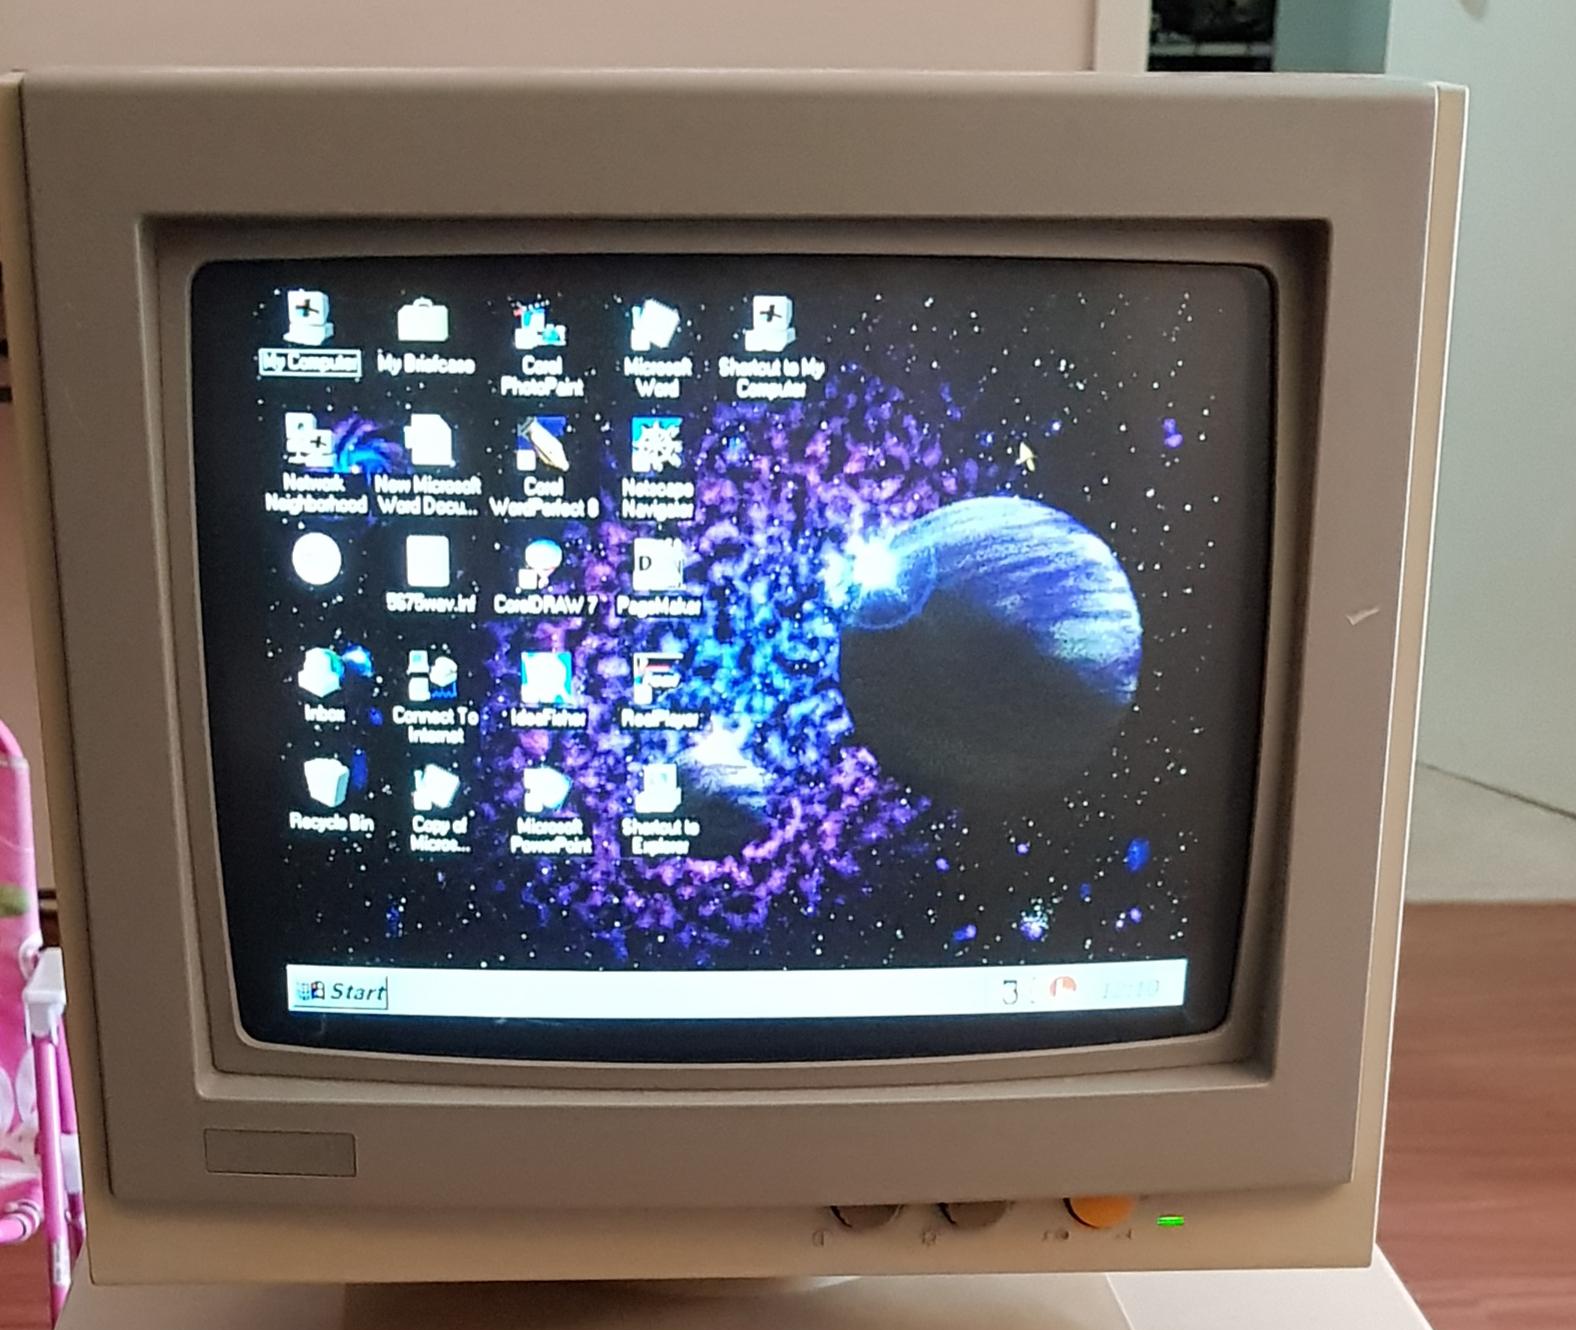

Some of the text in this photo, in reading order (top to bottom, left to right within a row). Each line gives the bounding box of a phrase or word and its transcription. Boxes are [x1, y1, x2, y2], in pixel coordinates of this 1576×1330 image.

[377, 353, 402, 375] My
[783, 358, 799, 377] to
[802, 357, 826, 380] My
[635, 378, 680, 398] Word
[736, 379, 807, 401] Computer
[283, 473, 346, 492] Network
[375, 474, 482, 495] New Microsoft
[377, 495, 420, 515] Word
[289, 812, 375, 833] Recycle Bin
[413, 815, 451, 836] Copy
[330, 982, 387, 1002] Start
